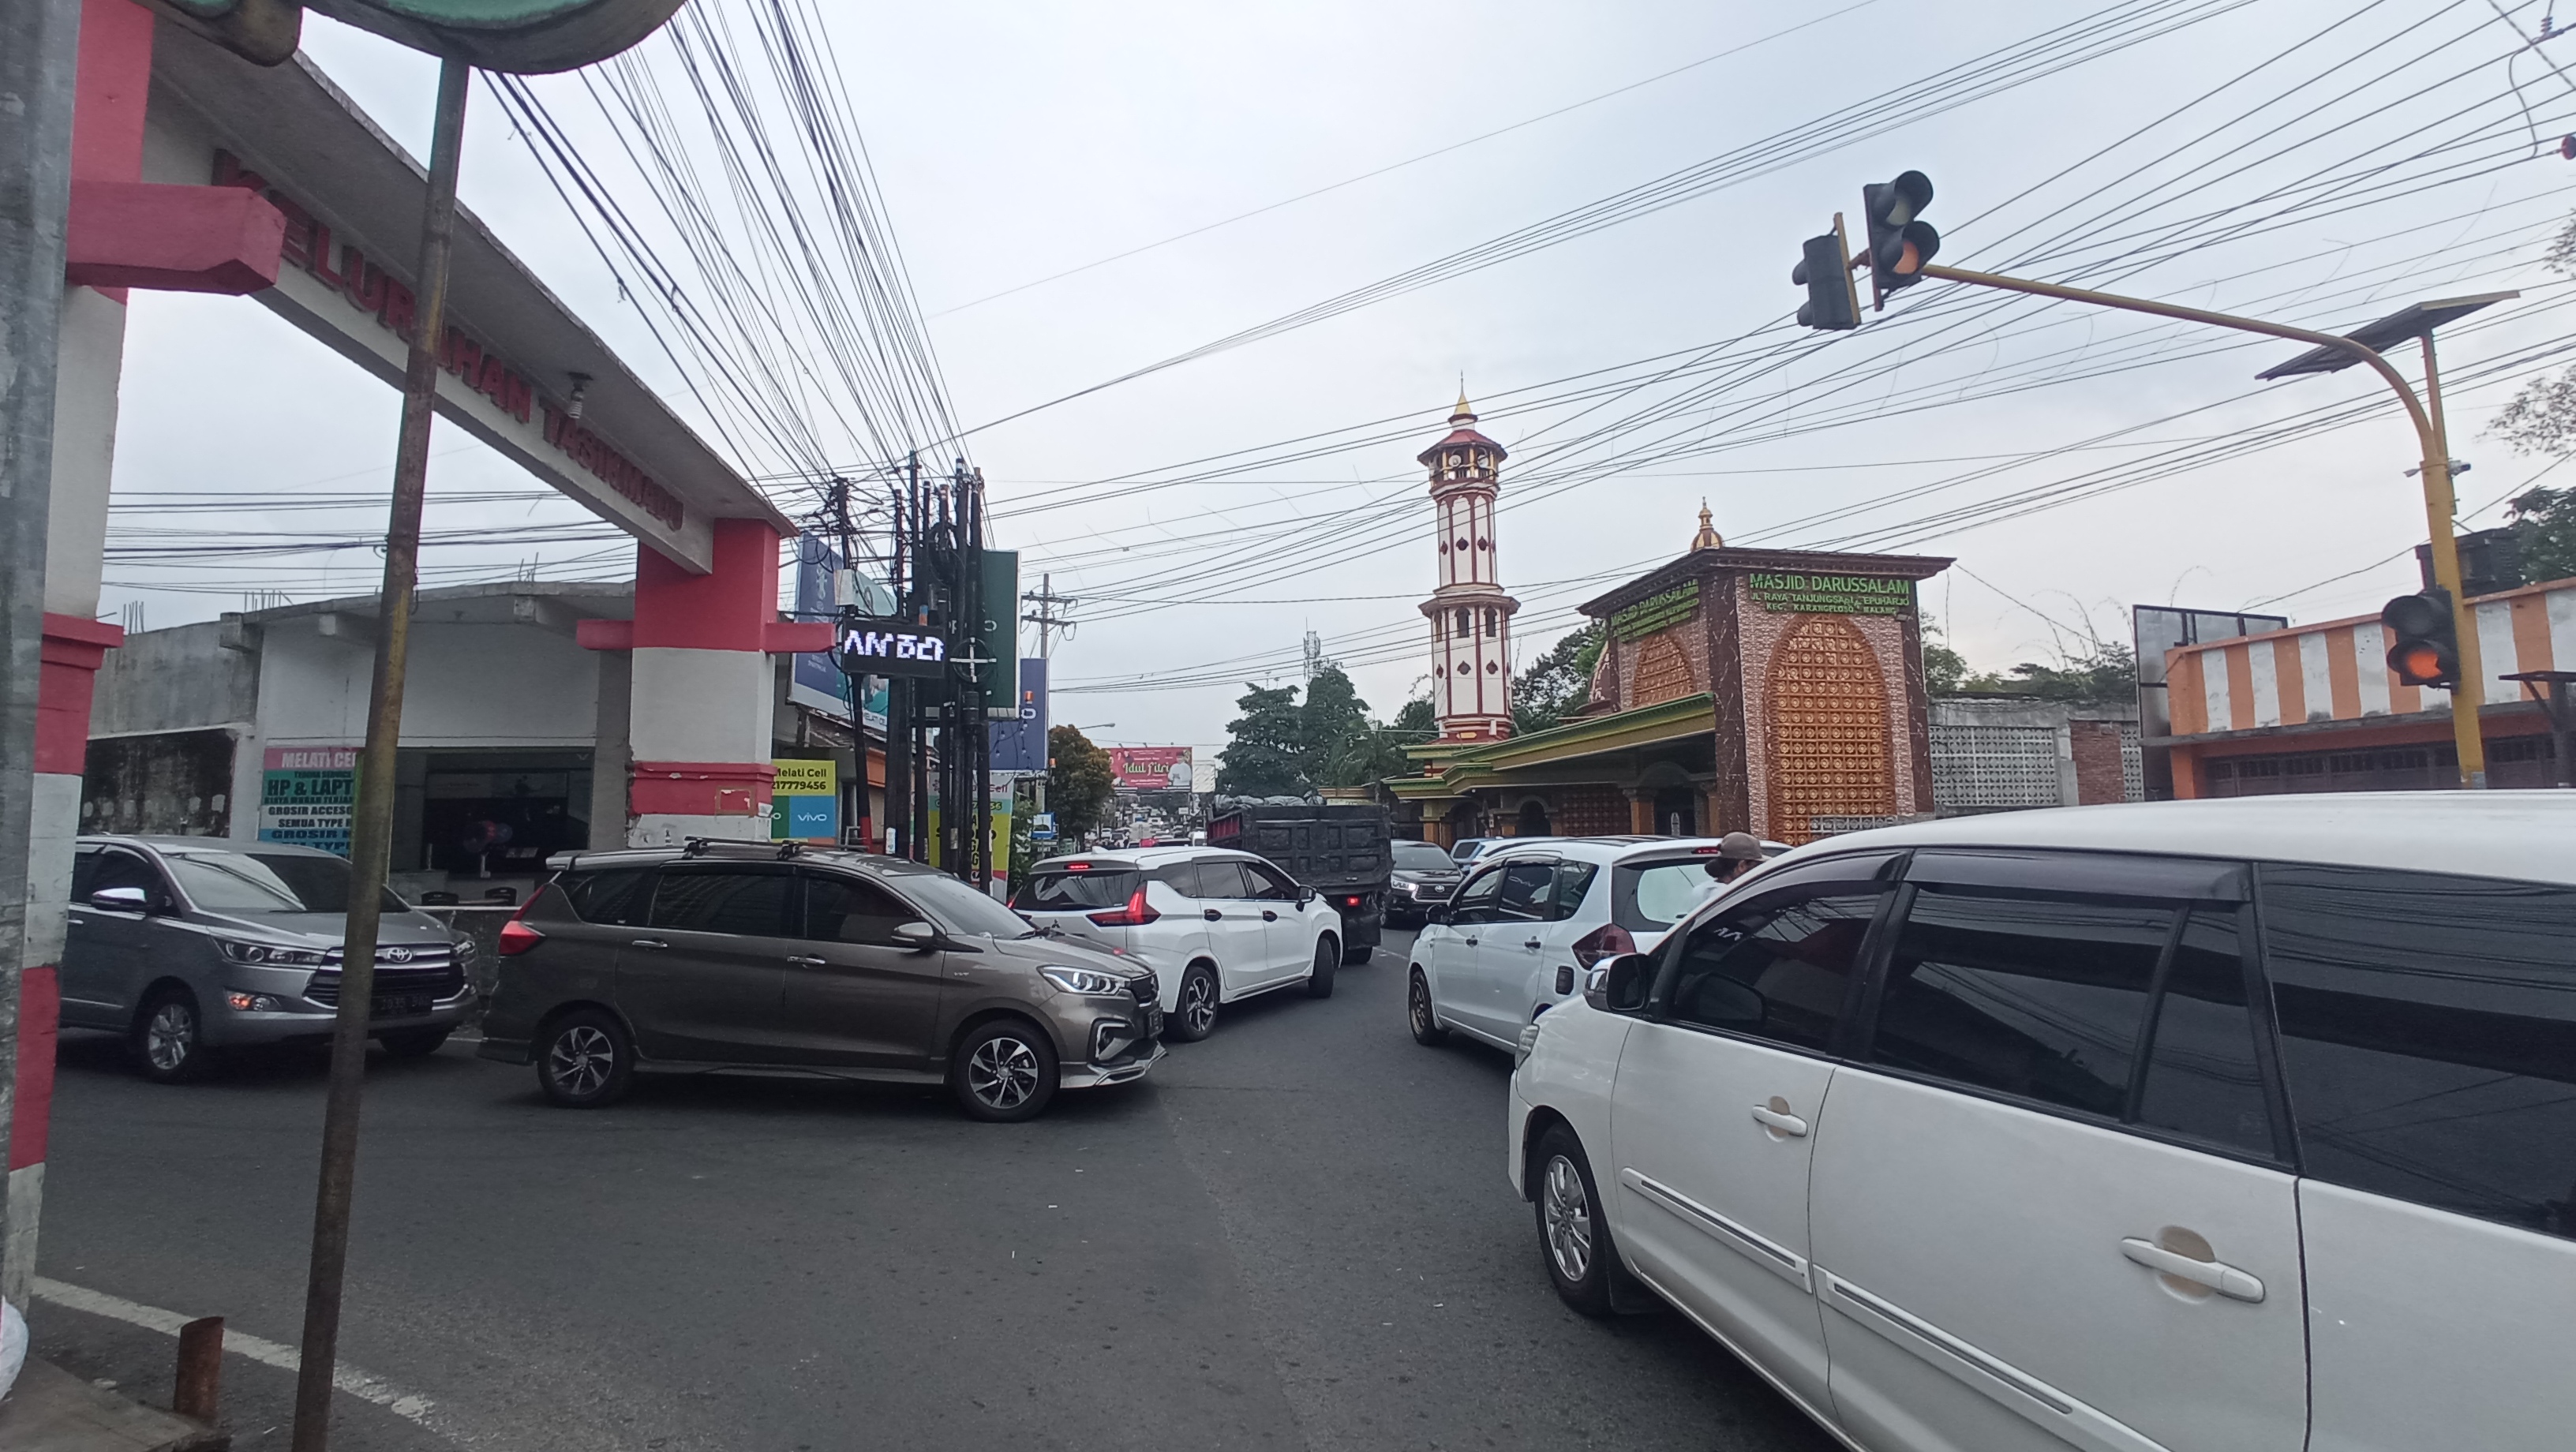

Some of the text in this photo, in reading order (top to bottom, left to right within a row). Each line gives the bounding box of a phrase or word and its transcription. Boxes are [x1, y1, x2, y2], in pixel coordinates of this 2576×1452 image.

[1750, 573, 1909, 593] MASJID DARUSSALAM
[1764, 593, 1788, 602] RAYA
[282, 752, 331, 768] MELATI
[1122, 762, 1146, 774] Idul
[807, 769, 826, 777] Cell
[267, 779, 291, 796] HP
[294, 781, 307, 795] &
[268, 806, 309, 815] GROSIR
[798, 812, 827, 821] vivo
[278, 819, 316, 828] SEMUA
[317, 819, 343, 828] TYPE
[271, 830, 337, 839] GROSIR
